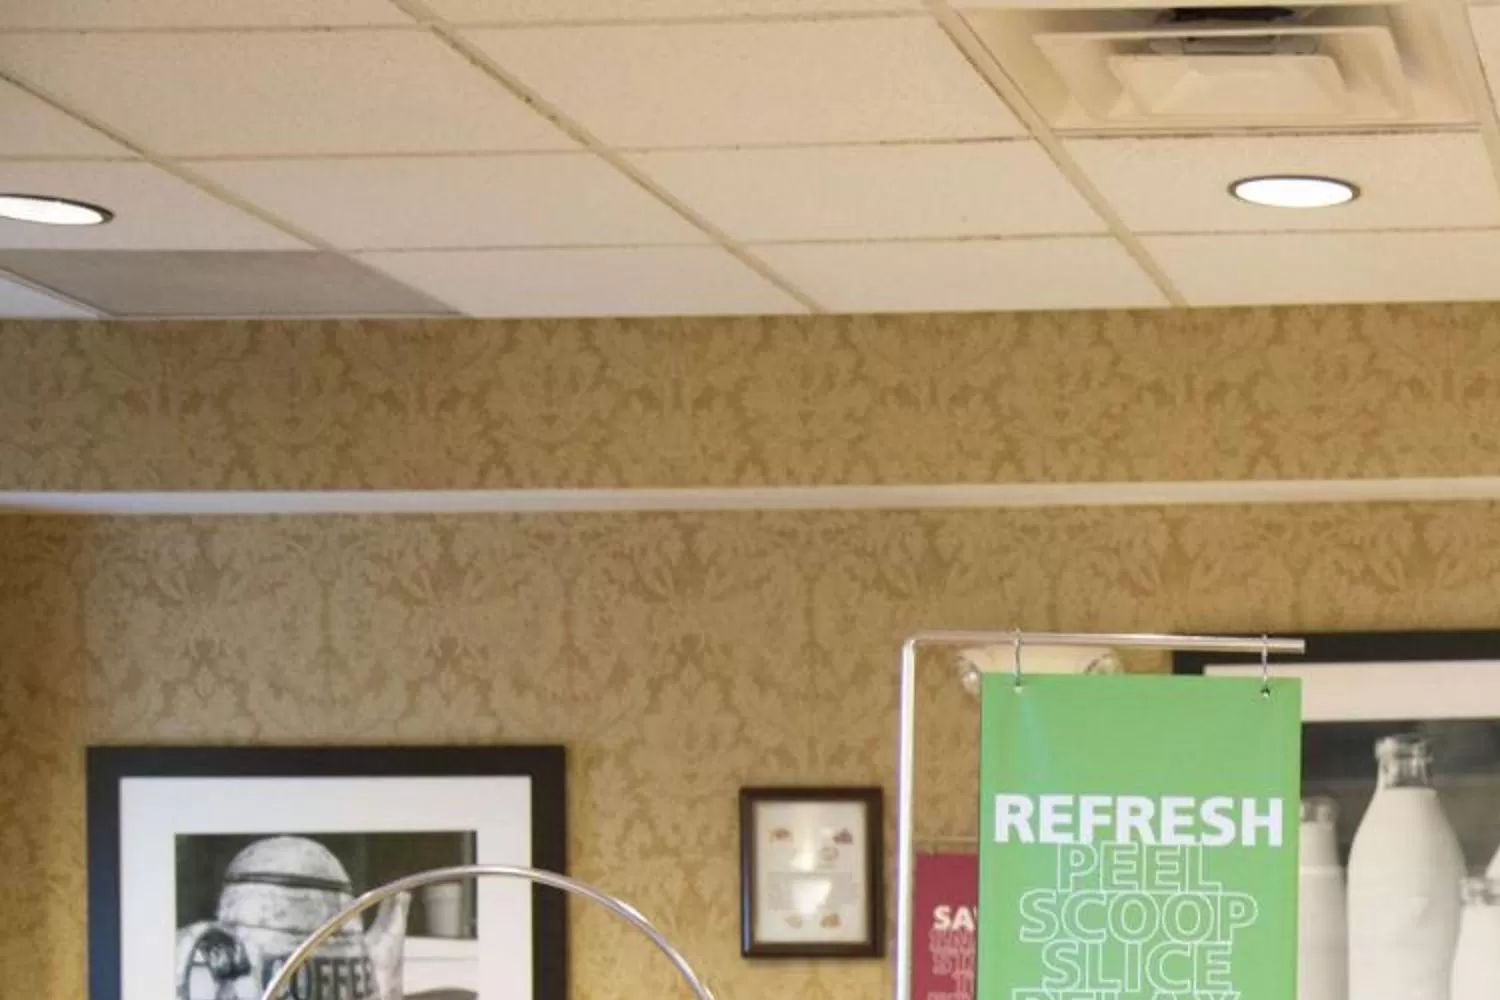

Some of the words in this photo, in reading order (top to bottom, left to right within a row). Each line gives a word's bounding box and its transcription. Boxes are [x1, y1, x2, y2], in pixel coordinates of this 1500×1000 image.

[993, 794, 1284, 847] REFRESH
[1057, 842, 1222, 893] PEEL
[933, 905, 977, 932] SA
[1018, 888, 1259, 944] SCOOP
[1041, 939, 1232, 993] SLICE
